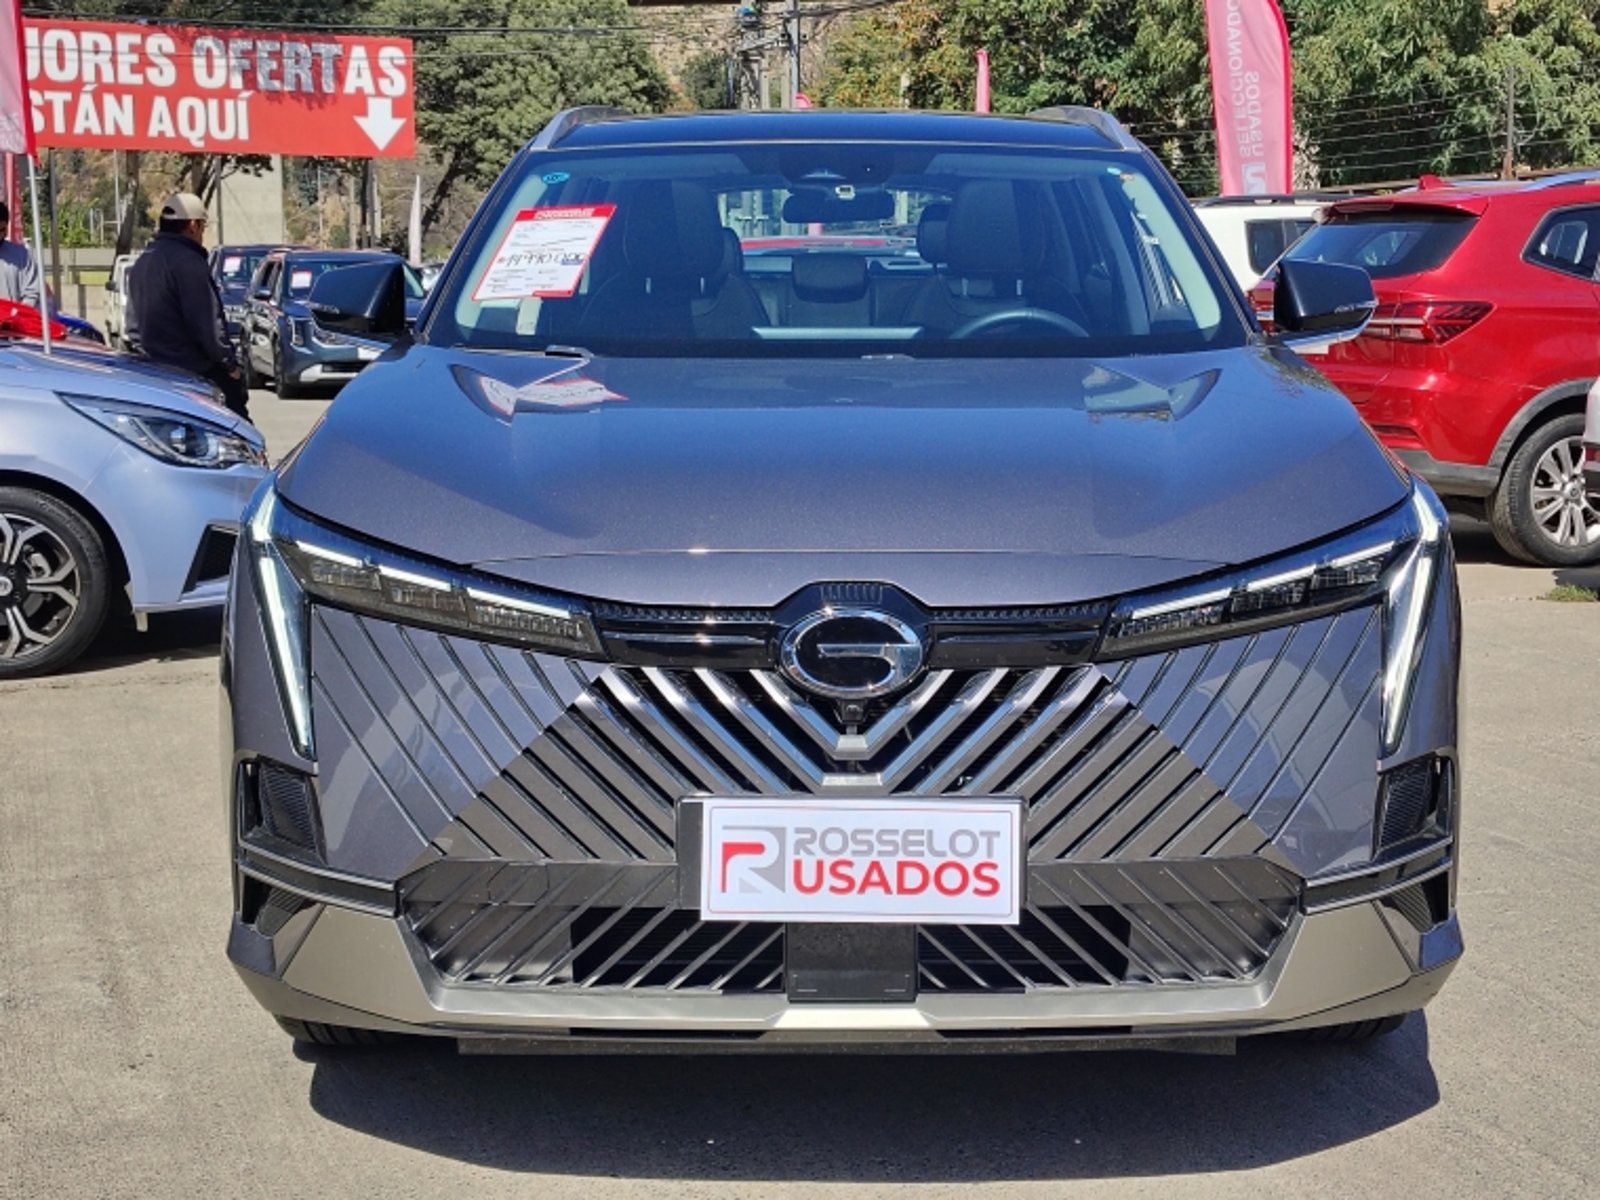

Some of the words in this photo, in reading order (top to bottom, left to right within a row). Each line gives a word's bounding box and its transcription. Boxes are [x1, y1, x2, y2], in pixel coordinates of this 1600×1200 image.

[192, 35, 407, 97] OFERTAS
[148, 90, 253, 147] AQUÍ
[793, 827, 1001, 858] ROSSELOT
[793, 859, 1001, 898] USADOS
